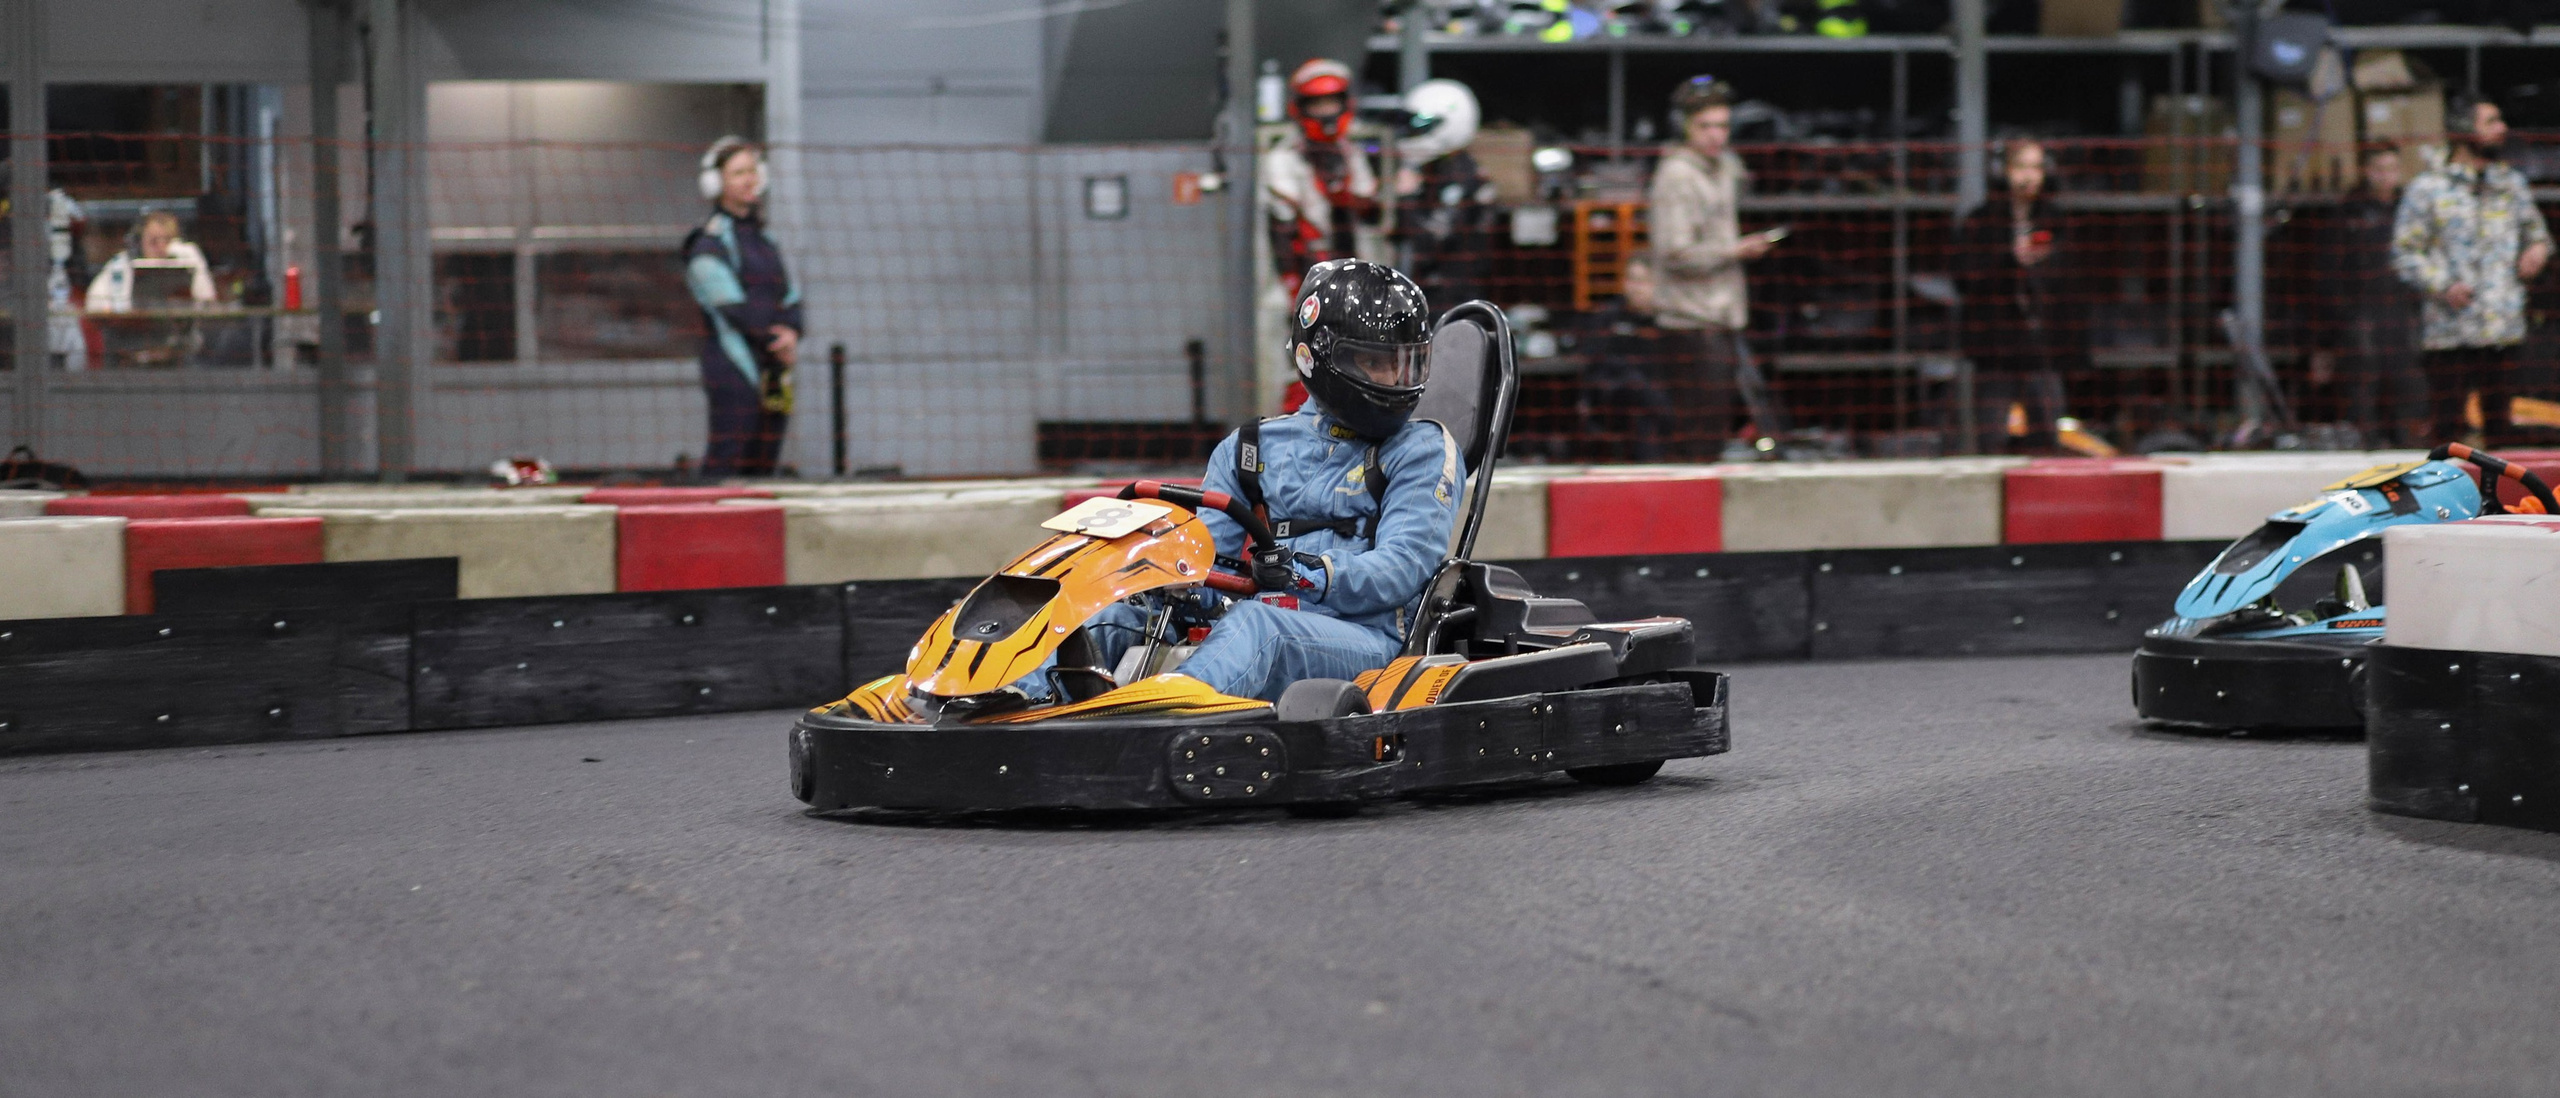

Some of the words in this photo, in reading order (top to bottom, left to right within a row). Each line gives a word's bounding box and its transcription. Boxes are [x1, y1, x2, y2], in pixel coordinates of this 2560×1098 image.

[1077, 508, 1133, 527] 8
[1280, 525, 1286, 534] 2
[1264, 554, 1279, 563] OMP
[1425, 678, 1445, 704] OWER
